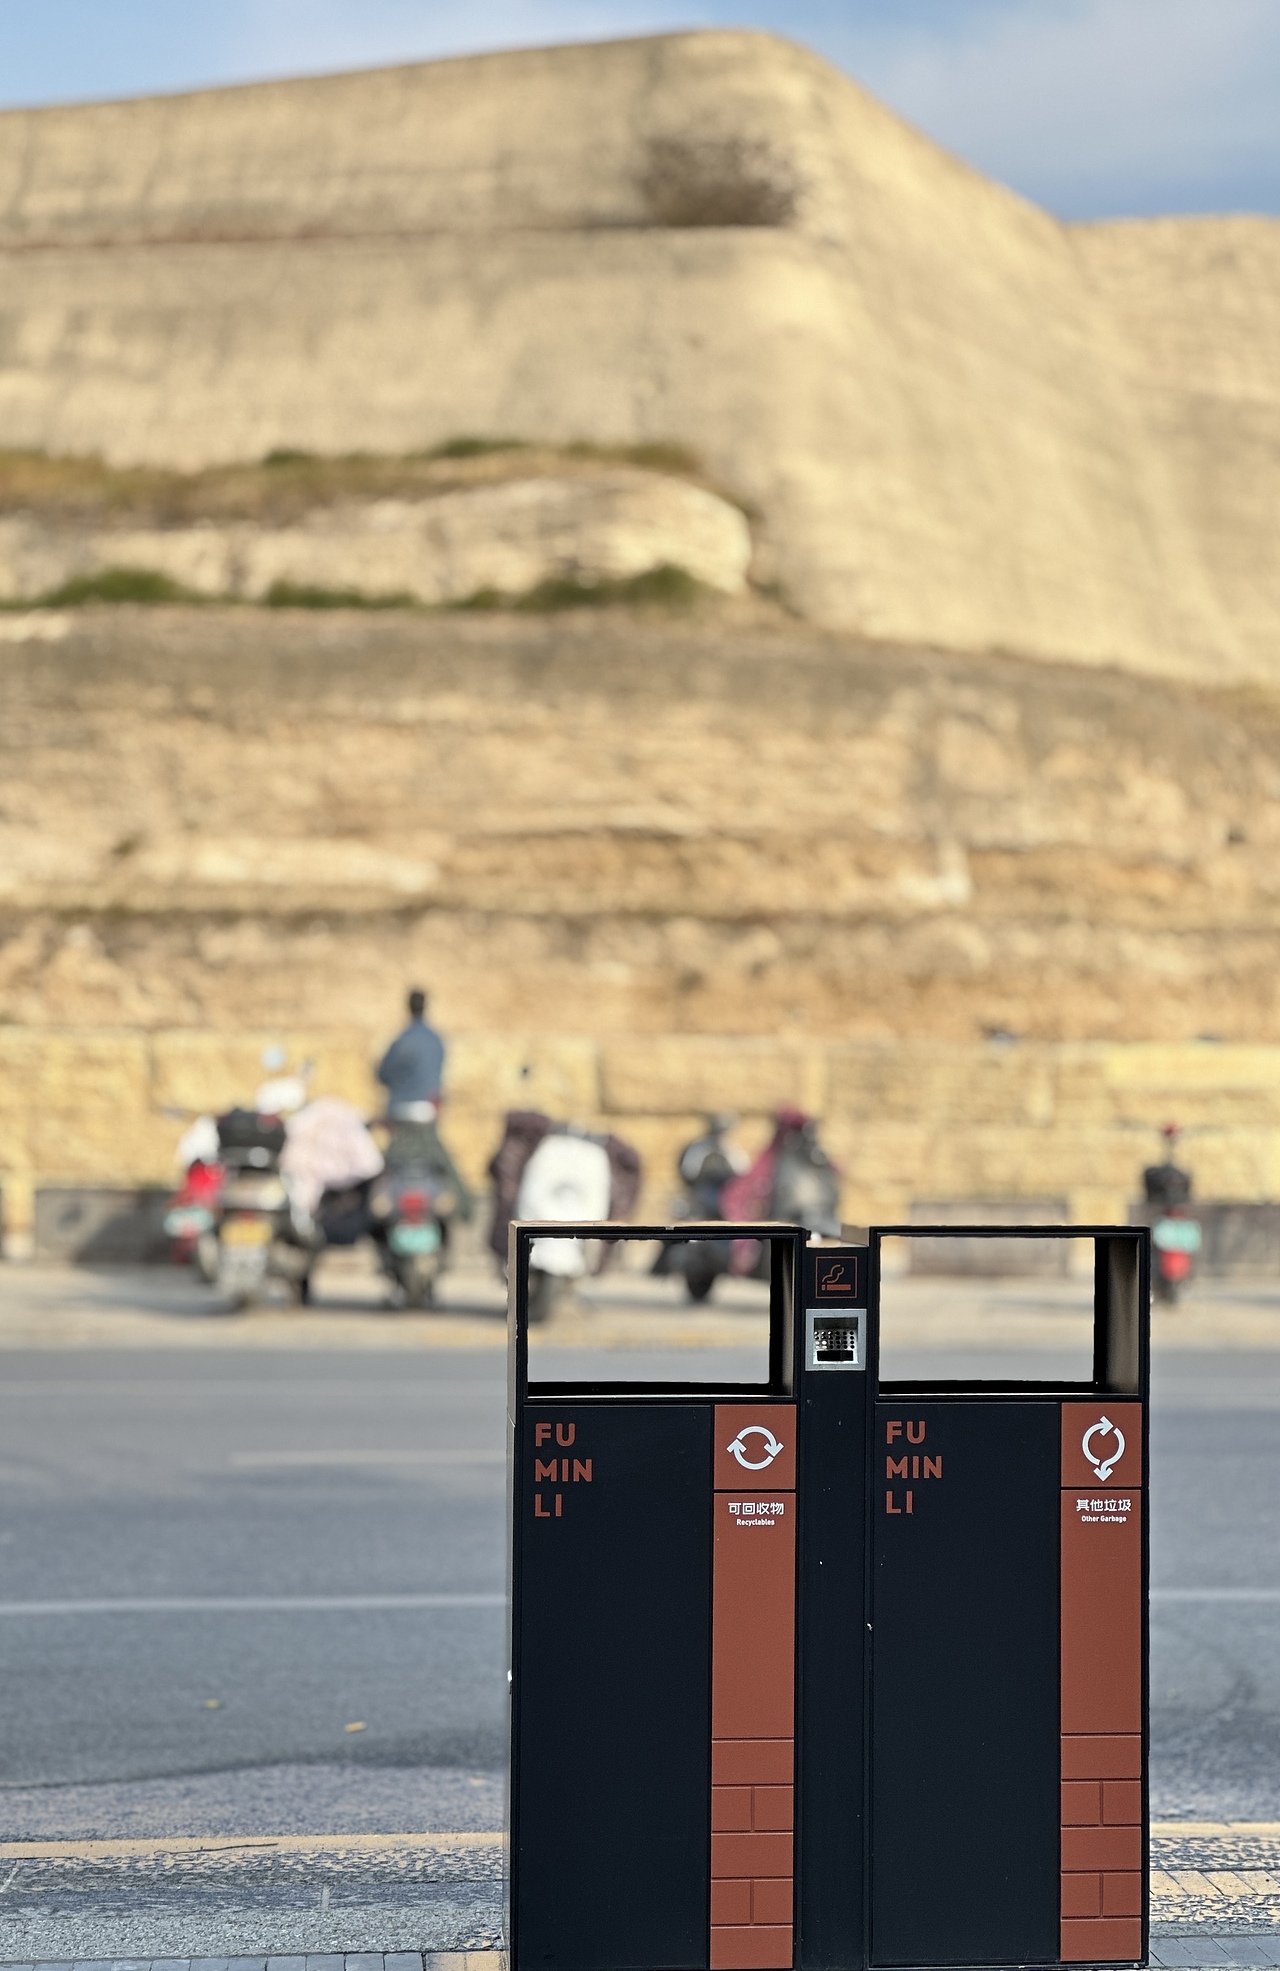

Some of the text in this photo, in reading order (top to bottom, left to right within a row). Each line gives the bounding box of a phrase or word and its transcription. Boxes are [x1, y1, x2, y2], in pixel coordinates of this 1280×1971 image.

[535, 1423, 575, 1447] FU
[886, 1421, 926, 1444] FU
[535, 1459, 592, 1482] MIN
[886, 1456, 943, 1479] MIN
[535, 1494, 562, 1517] LI
[727, 1501, 785, 1516] 可回收物
[886, 1491, 913, 1514] LI
[1075, 1498, 1132, 1512] 其他垃圾
[736, 1518, 776, 1528] Recyclables
[1081, 1515, 1127, 1524] Other Garbage
